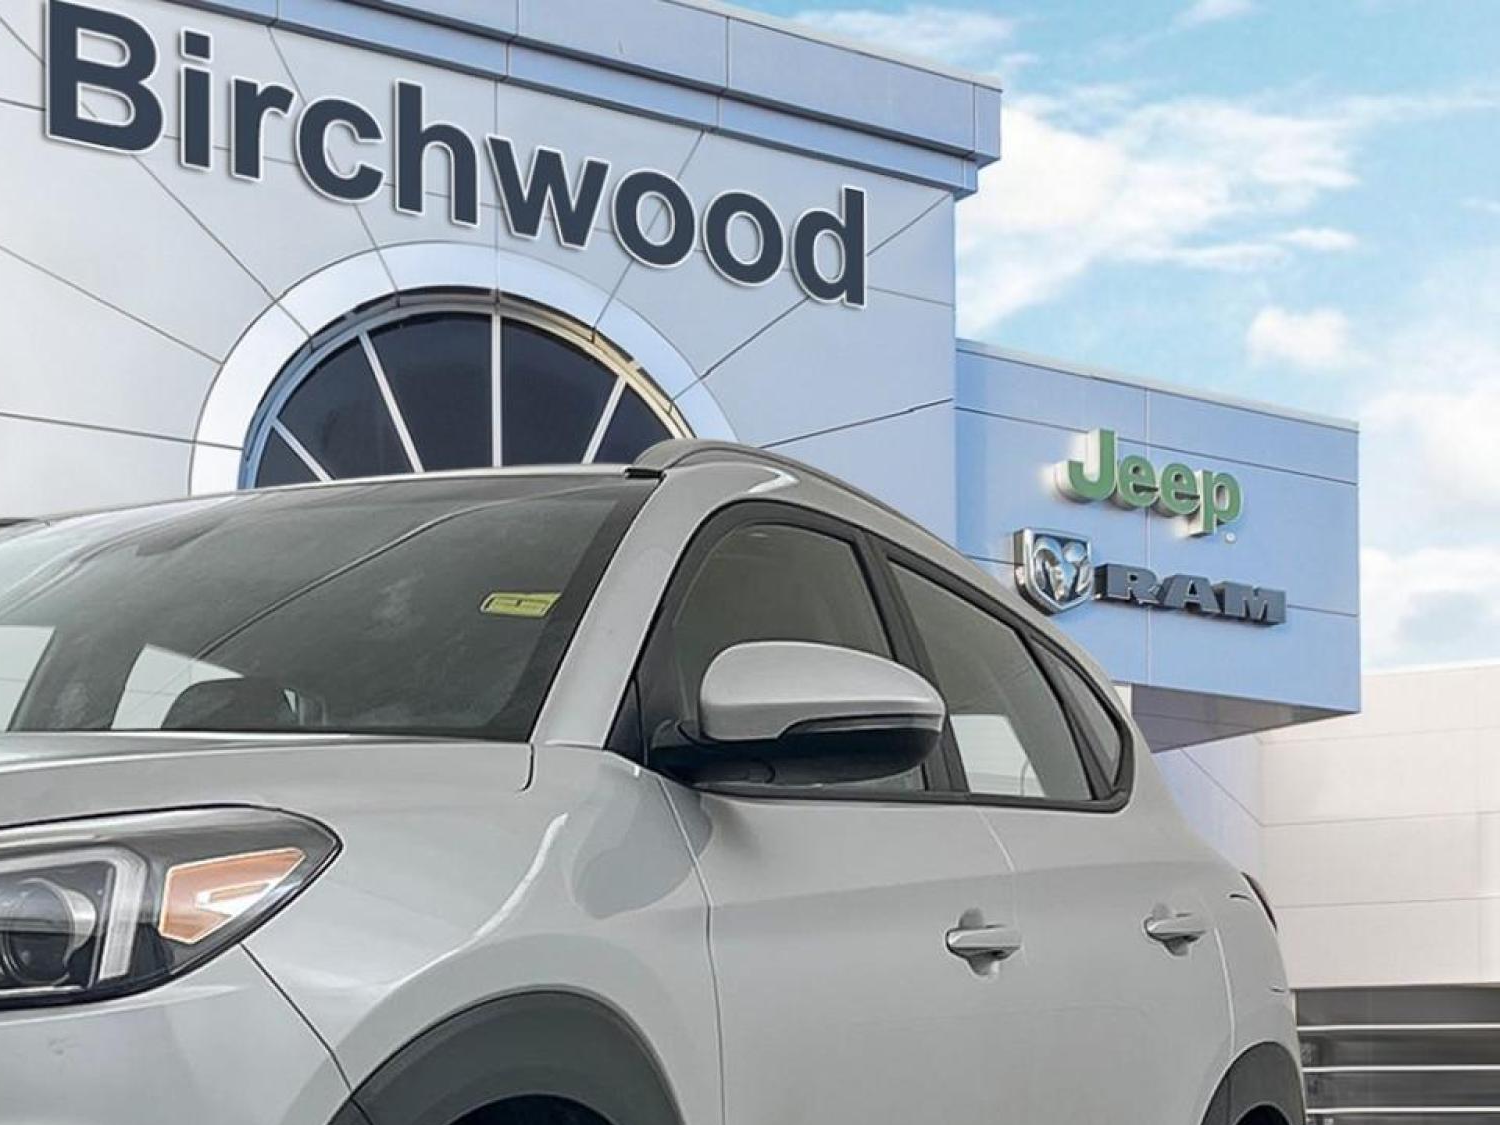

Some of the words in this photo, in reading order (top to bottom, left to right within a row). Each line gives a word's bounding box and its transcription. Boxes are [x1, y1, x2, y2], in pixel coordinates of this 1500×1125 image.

[46, 0, 868, 308] Birchwood
[1056, 428, 1242, 537] Jeep
[1095, 563, 1286, 624] RAM
